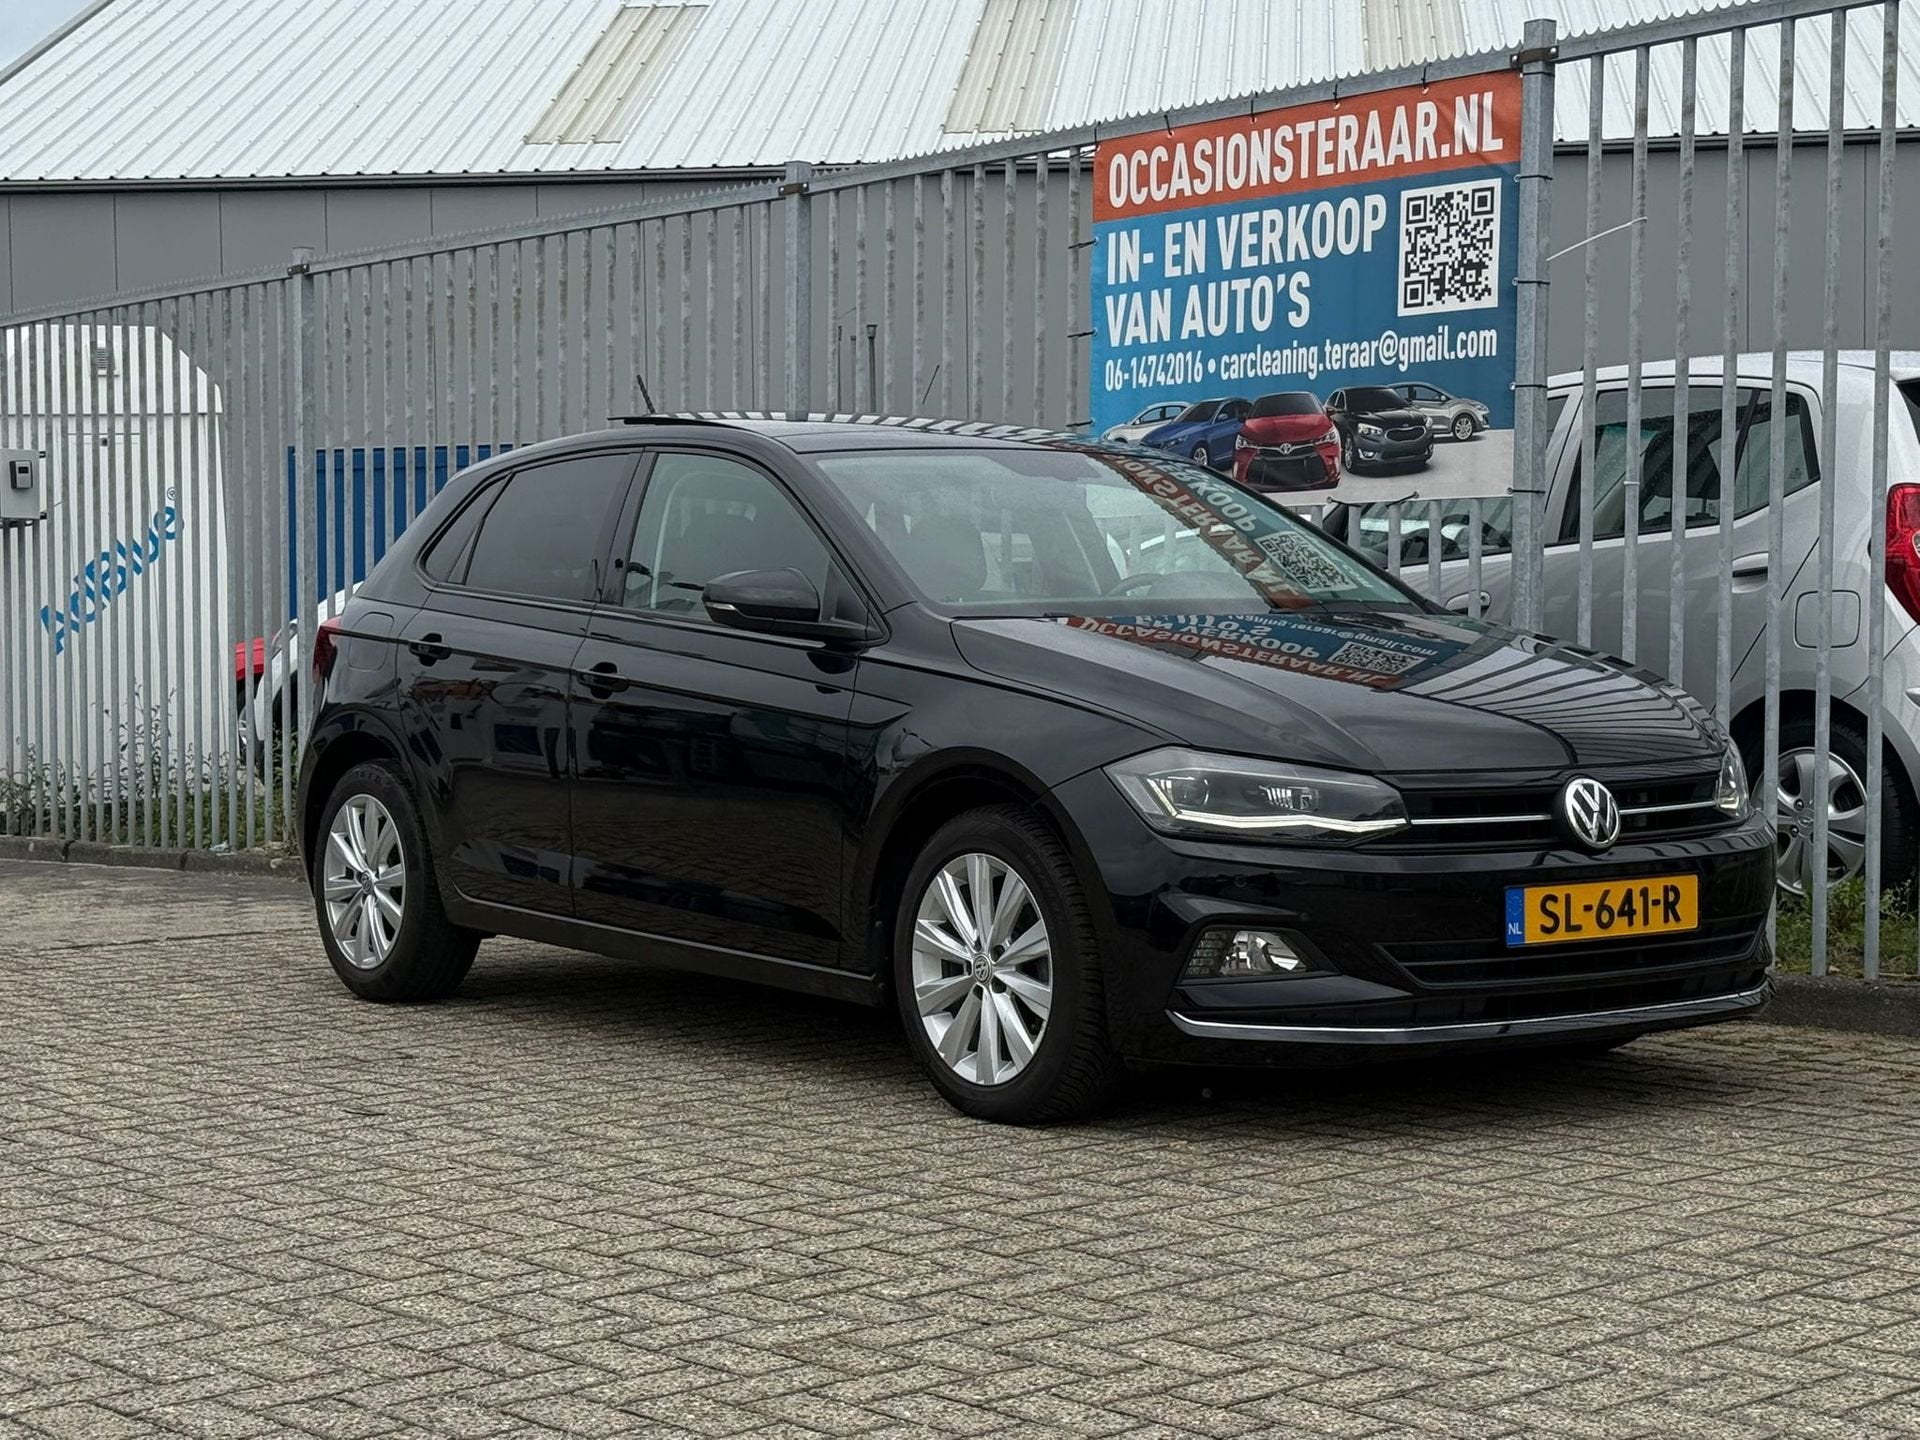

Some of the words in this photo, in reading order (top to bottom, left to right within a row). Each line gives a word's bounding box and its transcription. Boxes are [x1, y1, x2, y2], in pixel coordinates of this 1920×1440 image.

[1108, 91, 1504, 209] OCCASIONSTERAAR.NL
[1106, 229, 1154, 286] IN-
[1164, 218, 1207, 279] EN
[1217, 194, 1387, 272] VERKOOP
[1105, 288, 1172, 348] VAN
[1181, 271, 1311, 341] AUTO'S
[1105, 350, 1203, 392] 06-14742016
[1220, 325, 1498, 381] carcleaning.teraar@gmail.com
[1508, 922, 1522, 936] NL
[1539, 884, 1682, 935] SL-641-R
